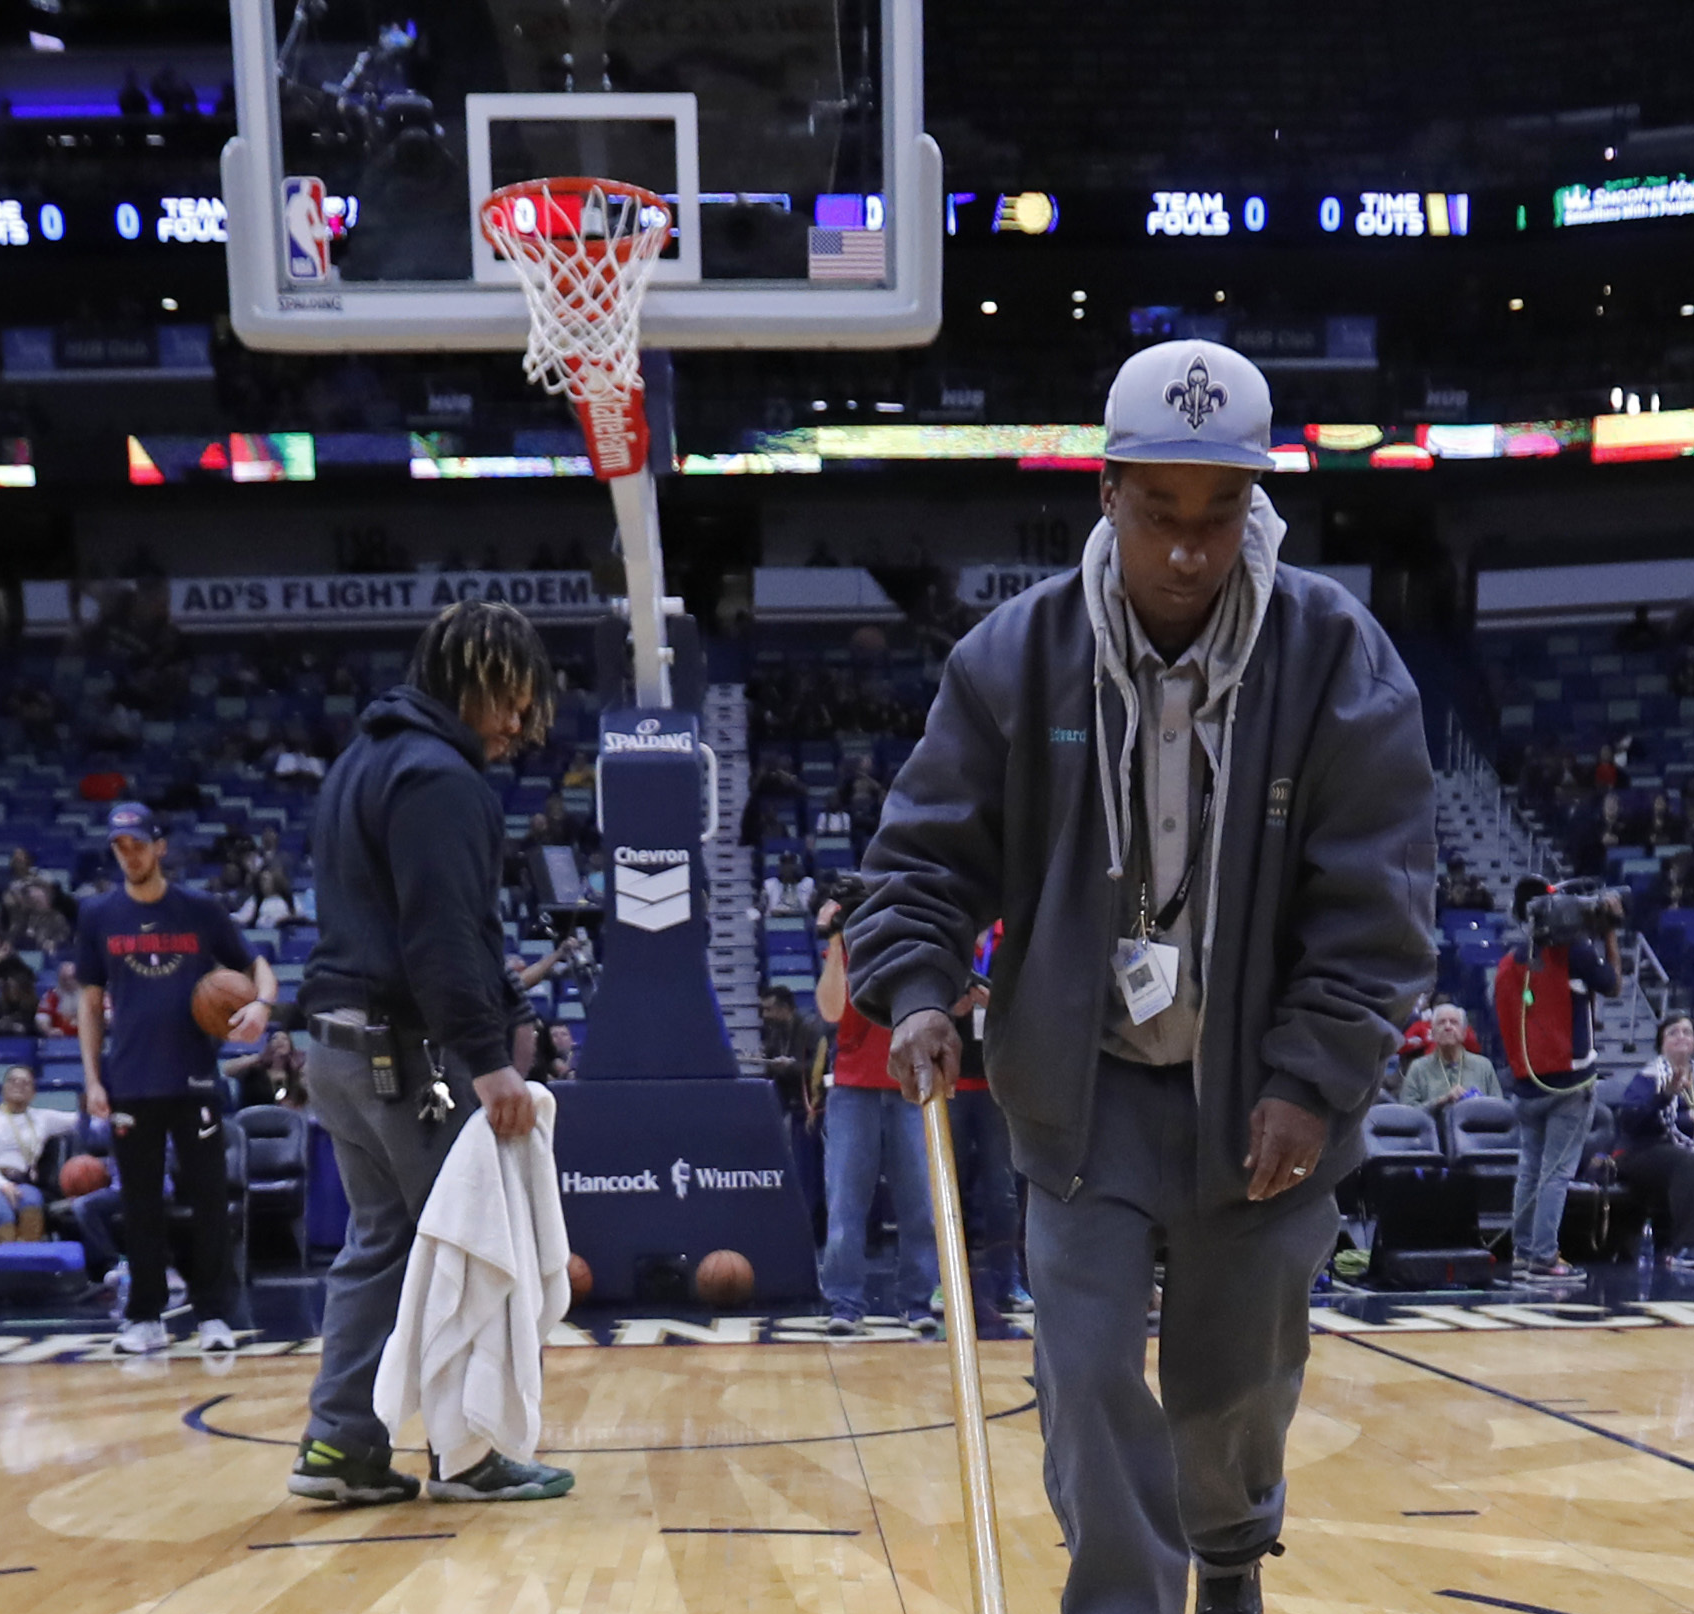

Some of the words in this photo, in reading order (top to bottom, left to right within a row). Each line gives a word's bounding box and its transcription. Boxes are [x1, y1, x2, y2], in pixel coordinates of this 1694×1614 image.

[1153, 192, 1223, 213] TEAM
[1242, 196, 1266, 232] 0
[1318, 196, 1342, 232] 0
[1360, 192, 1421, 213] TIME
[39, 203, 65, 241] 0
[115, 202, 141, 240] 0
[157, 217, 228, 242] FOUL
[1146, 211, 1230, 236] FOULS
[1355, 211, 1425, 236] OUTS
[183, 583, 268, 611] AD'S
[281, 580, 416, 609] FLIGHT
[433, 575, 591, 606] ACADEM
[604, 731, 694, 754] SPALDING
[614, 845, 690, 864] Chevron
[561, 1169, 661, 1193] Hancock
[695, 1167, 785, 1189] WHITNEY
